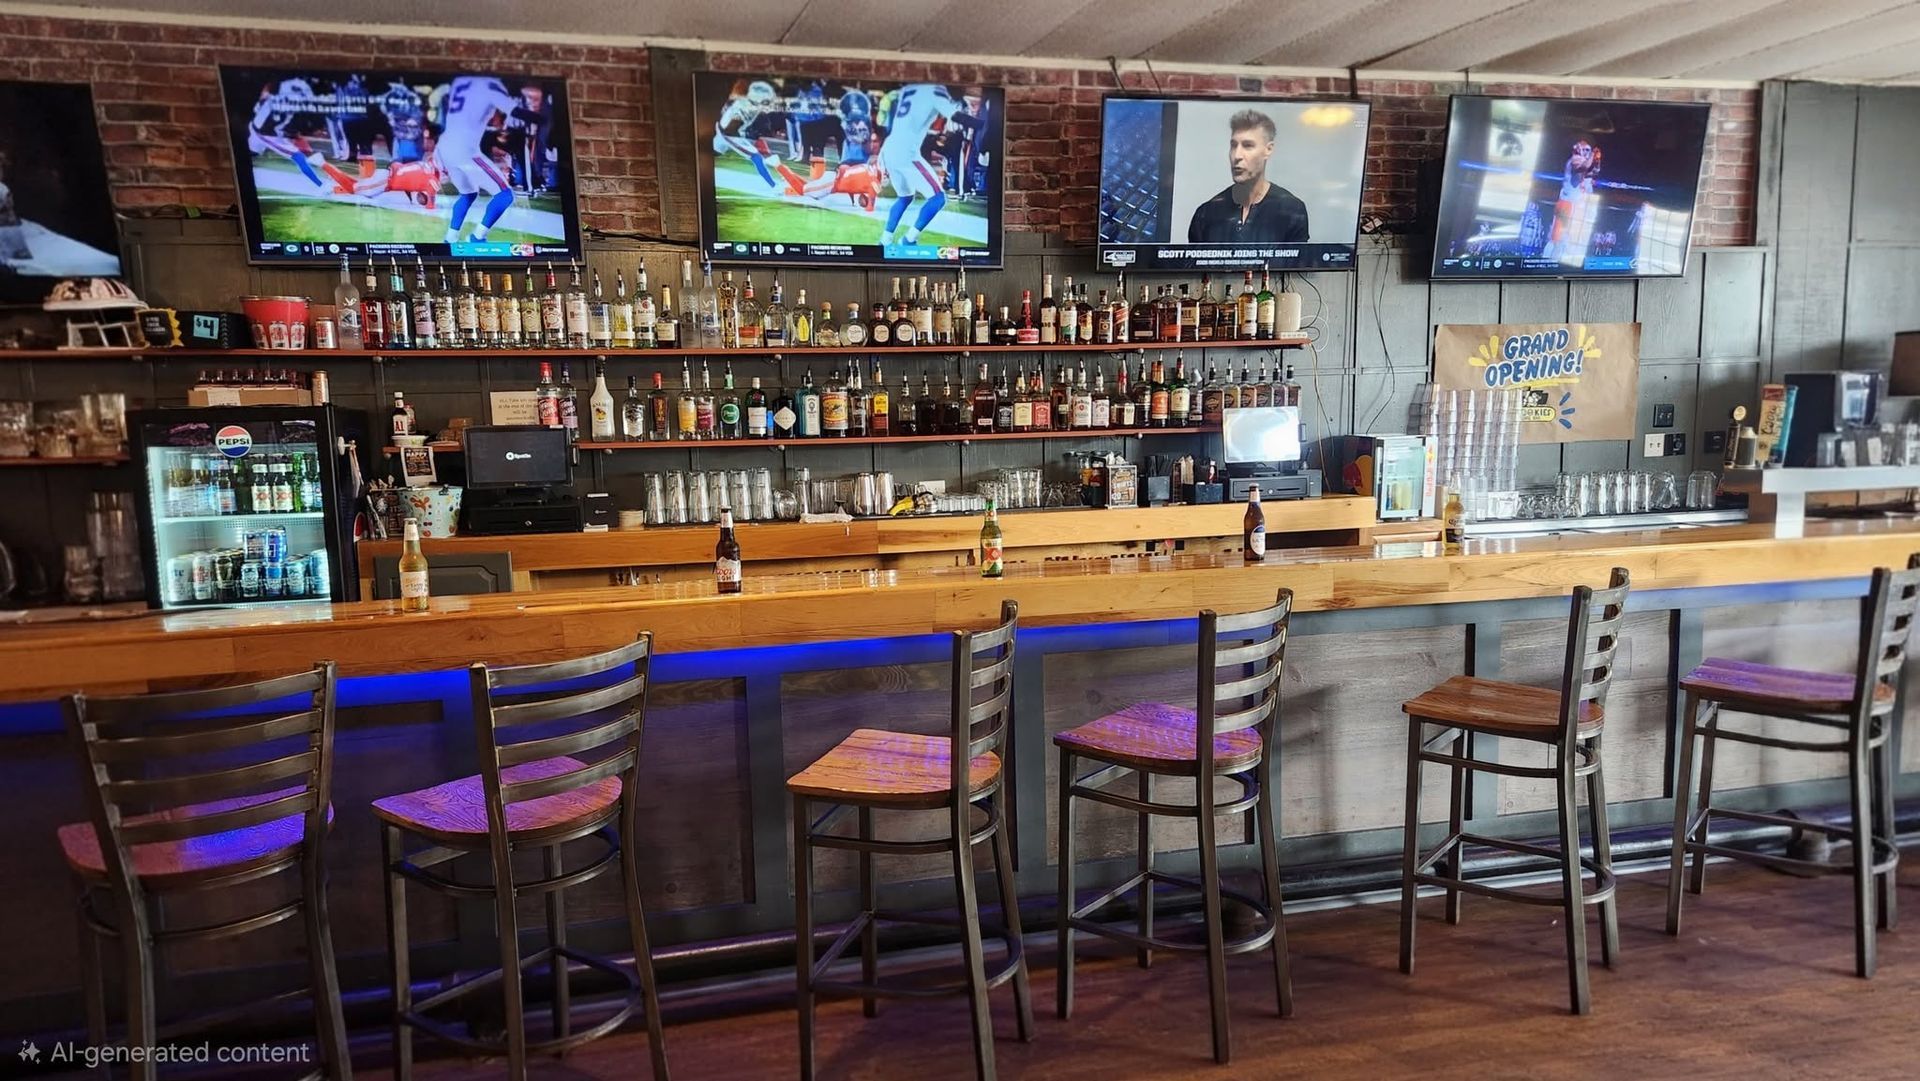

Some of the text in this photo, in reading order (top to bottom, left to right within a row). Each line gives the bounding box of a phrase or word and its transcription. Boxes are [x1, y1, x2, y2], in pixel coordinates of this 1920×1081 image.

[1157, 249, 1299, 258] SCOTT PODSEDNIK JOINS THE SHOW
[1504, 329, 1569, 360] GRAND
[1484, 349, 1584, 388] OPENING!
